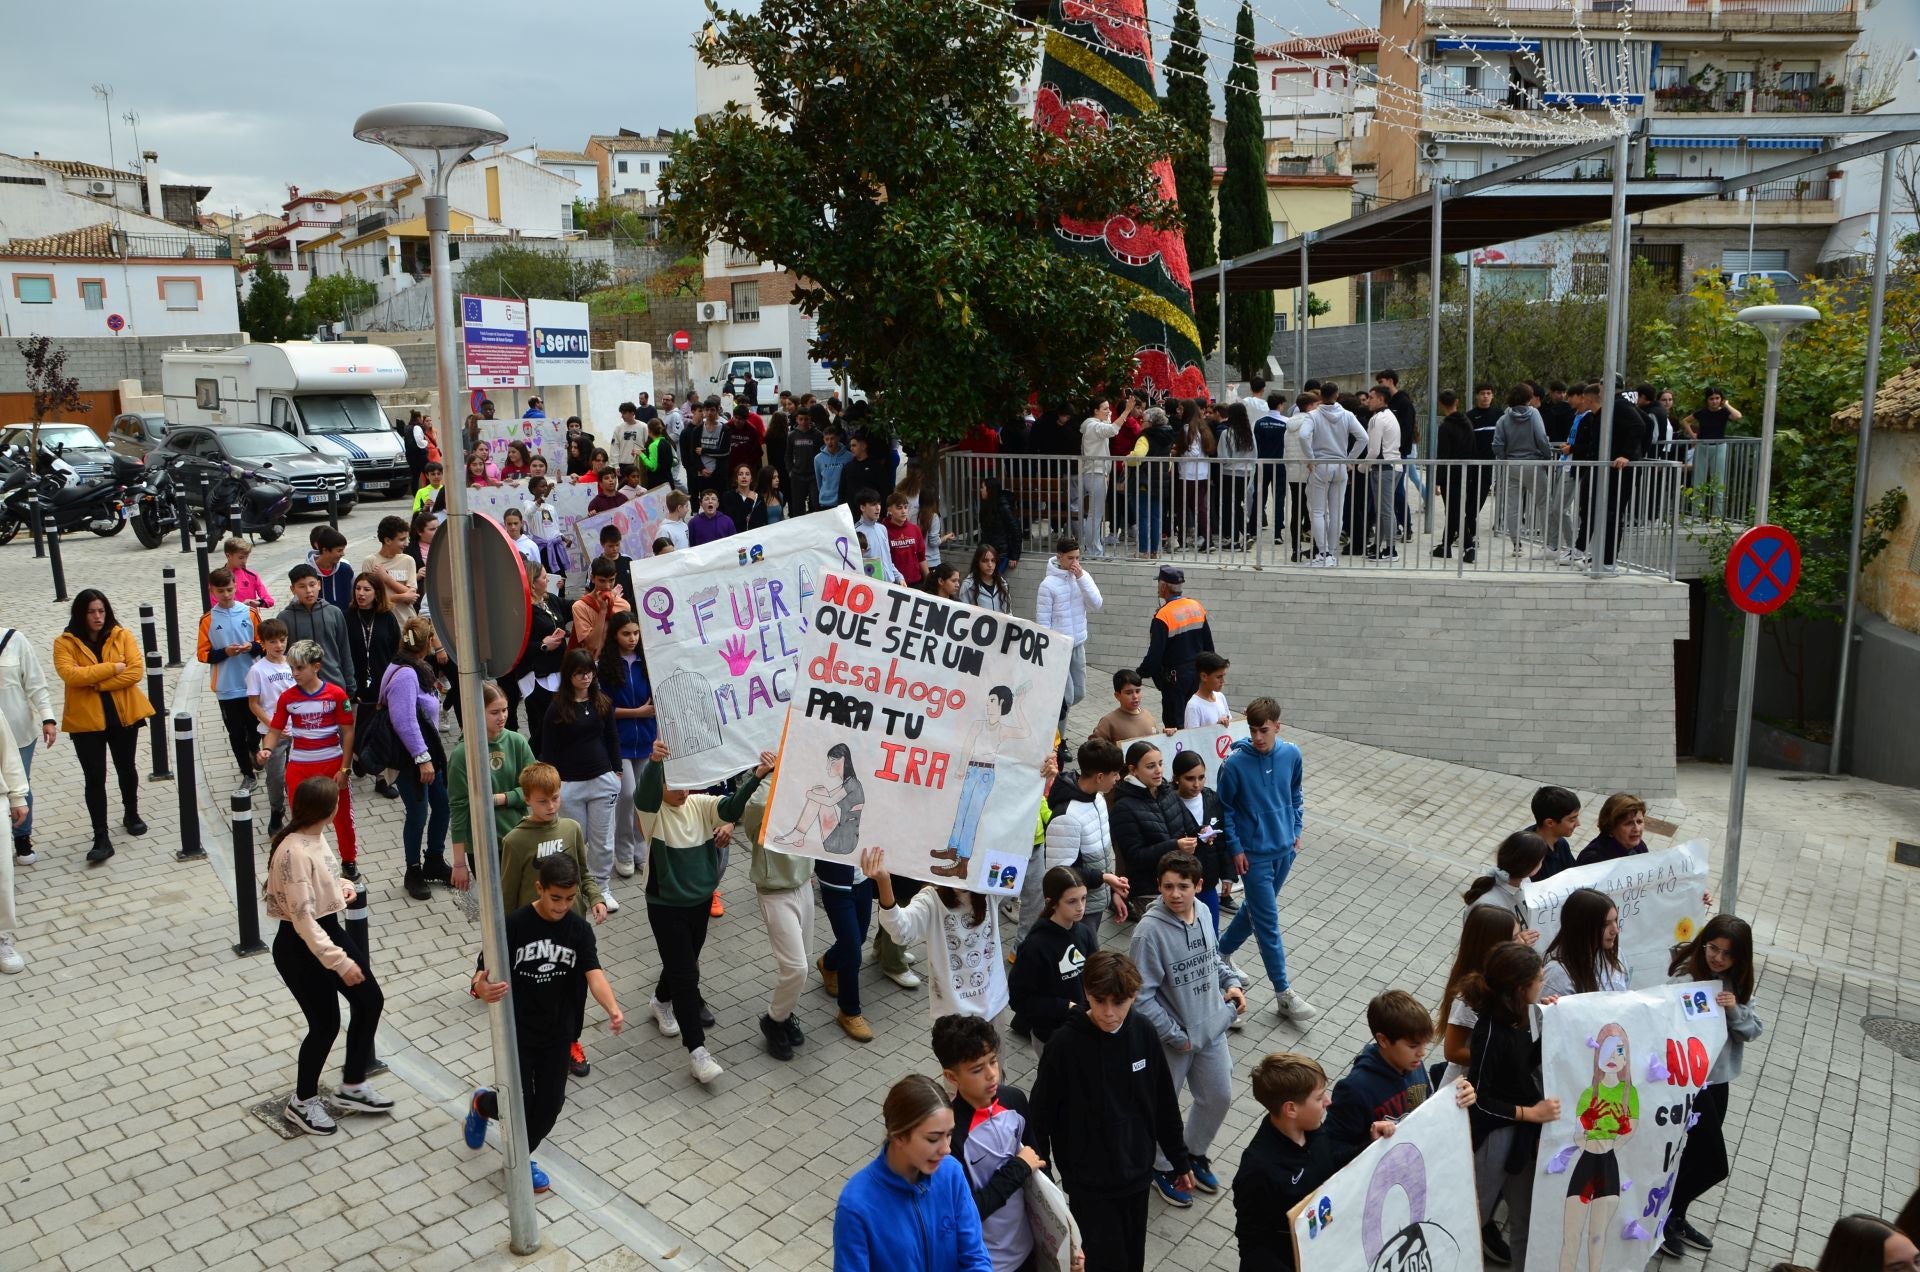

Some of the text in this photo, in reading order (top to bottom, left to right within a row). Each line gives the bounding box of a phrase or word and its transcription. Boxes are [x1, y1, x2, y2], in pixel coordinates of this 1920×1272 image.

[546, 335, 588, 352] sercli
[687, 564, 816, 645] FUERA
[821, 574, 1050, 667] NO TENGO POR
[760, 622, 798, 662] EL
[815, 605, 985, 677] QUÉ SER UN
[808, 642, 966, 718] desahogo
[805, 687, 925, 739] PARA TU
[874, 741, 950, 790] IRA
[537, 838, 563, 858] NIKE
[1608, 864, 1676, 892] BARRERA
[1622, 887, 1648, 903] QUE
[1657, 877, 1678, 895] NO
[1666, 1036, 1710, 1087] NO
